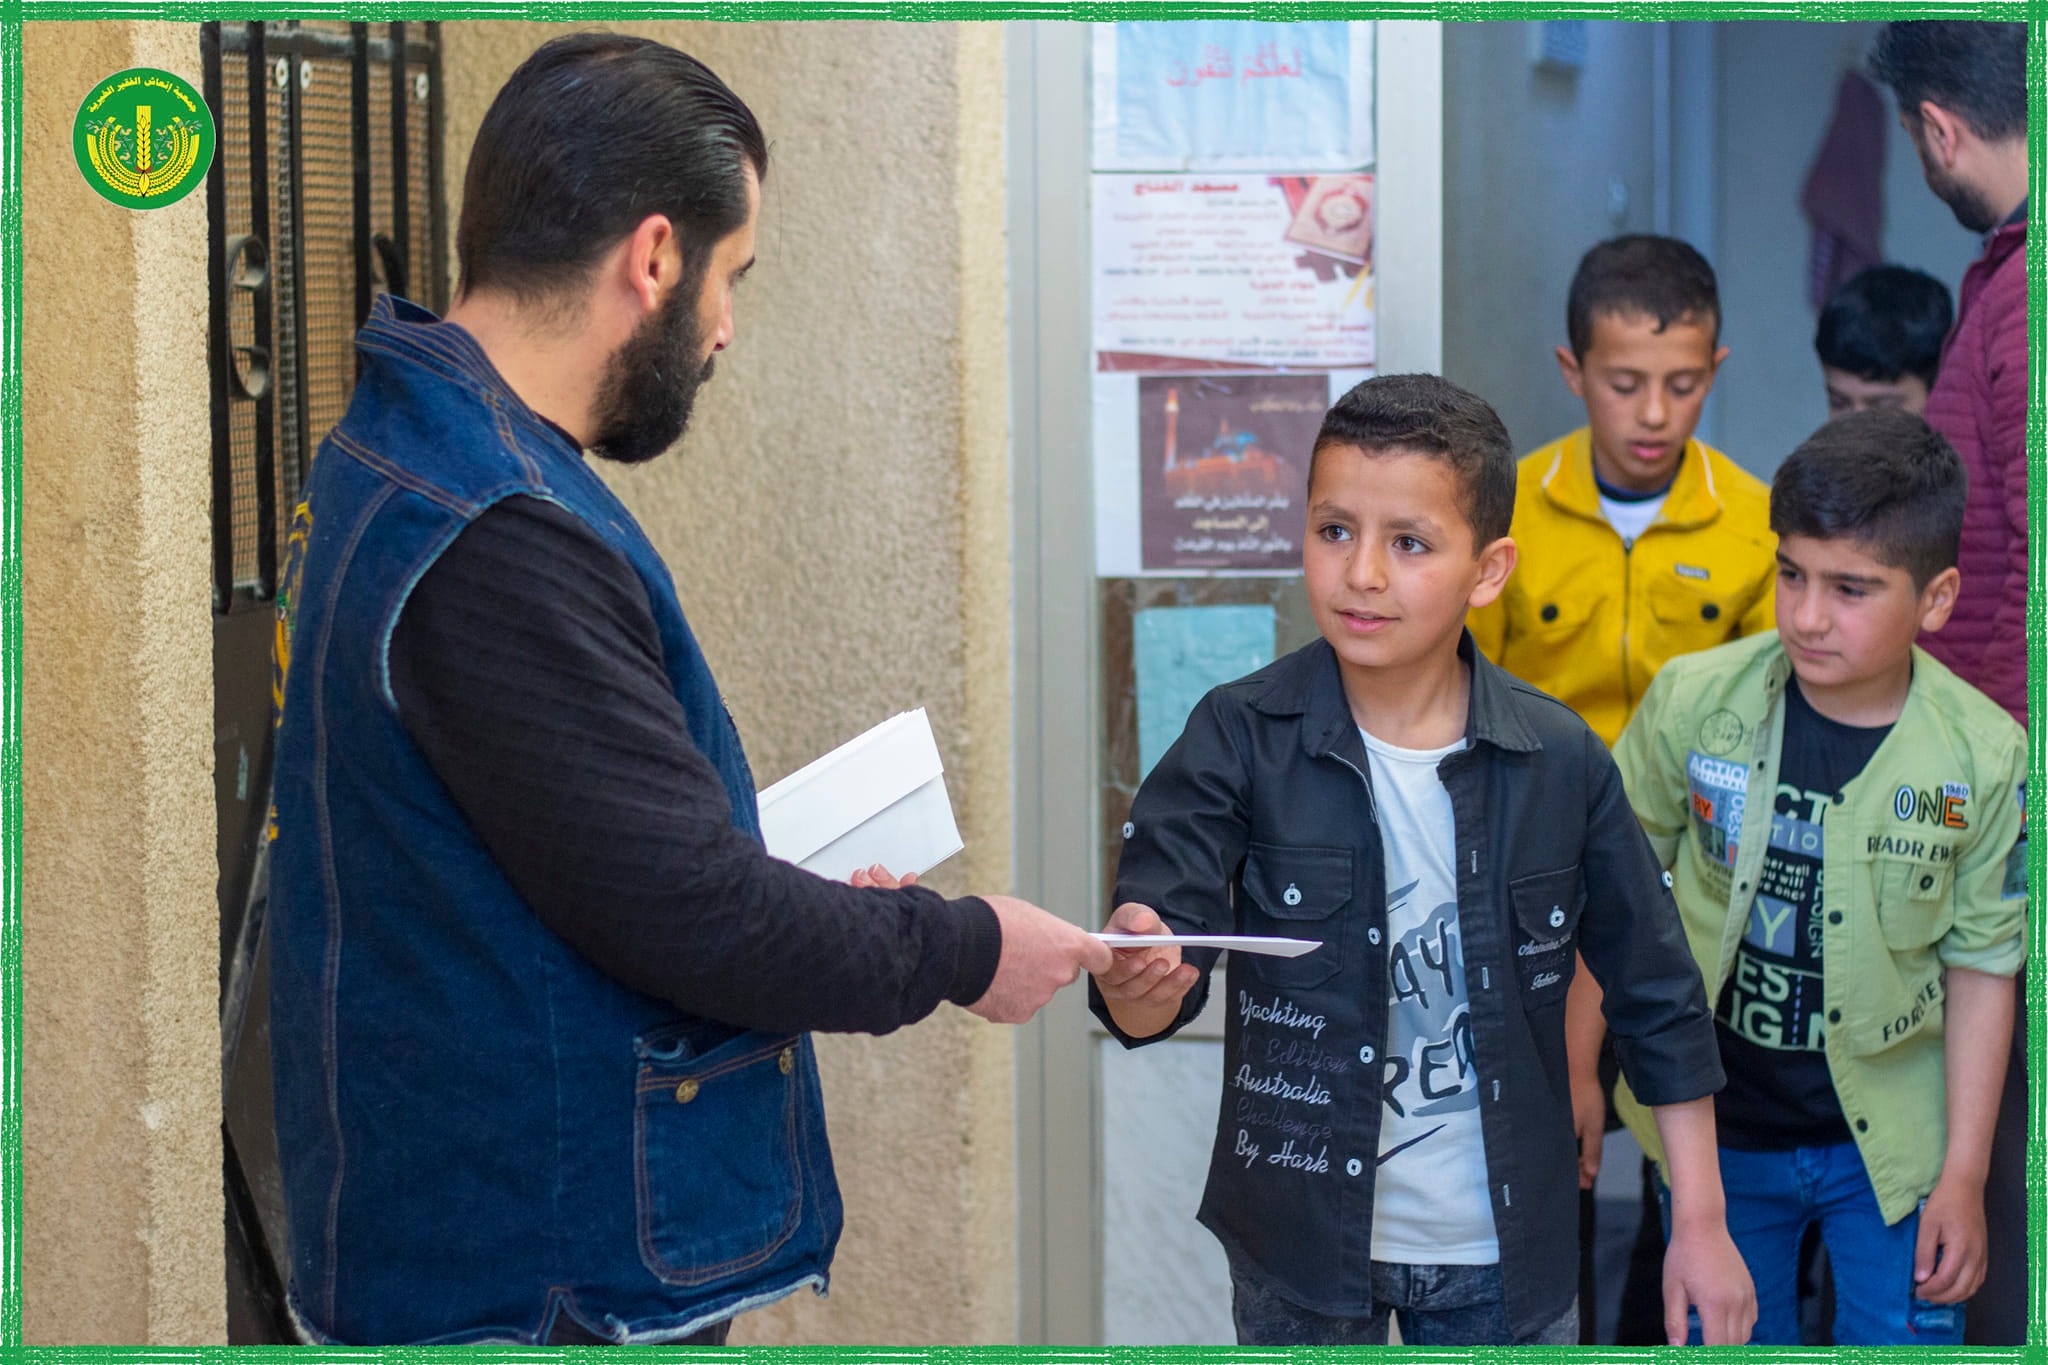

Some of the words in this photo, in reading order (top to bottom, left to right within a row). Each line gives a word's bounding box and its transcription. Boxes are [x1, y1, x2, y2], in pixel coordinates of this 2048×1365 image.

[1894, 784, 1969, 829] ONE
[1239, 989, 1327, 1040] Yachting
[1233, 1063, 1332, 1105] Australia
[1236, 1096, 1334, 1145] Challenge
[1234, 1128, 1261, 1169] By
[1266, 1139, 1330, 1175] Hark
